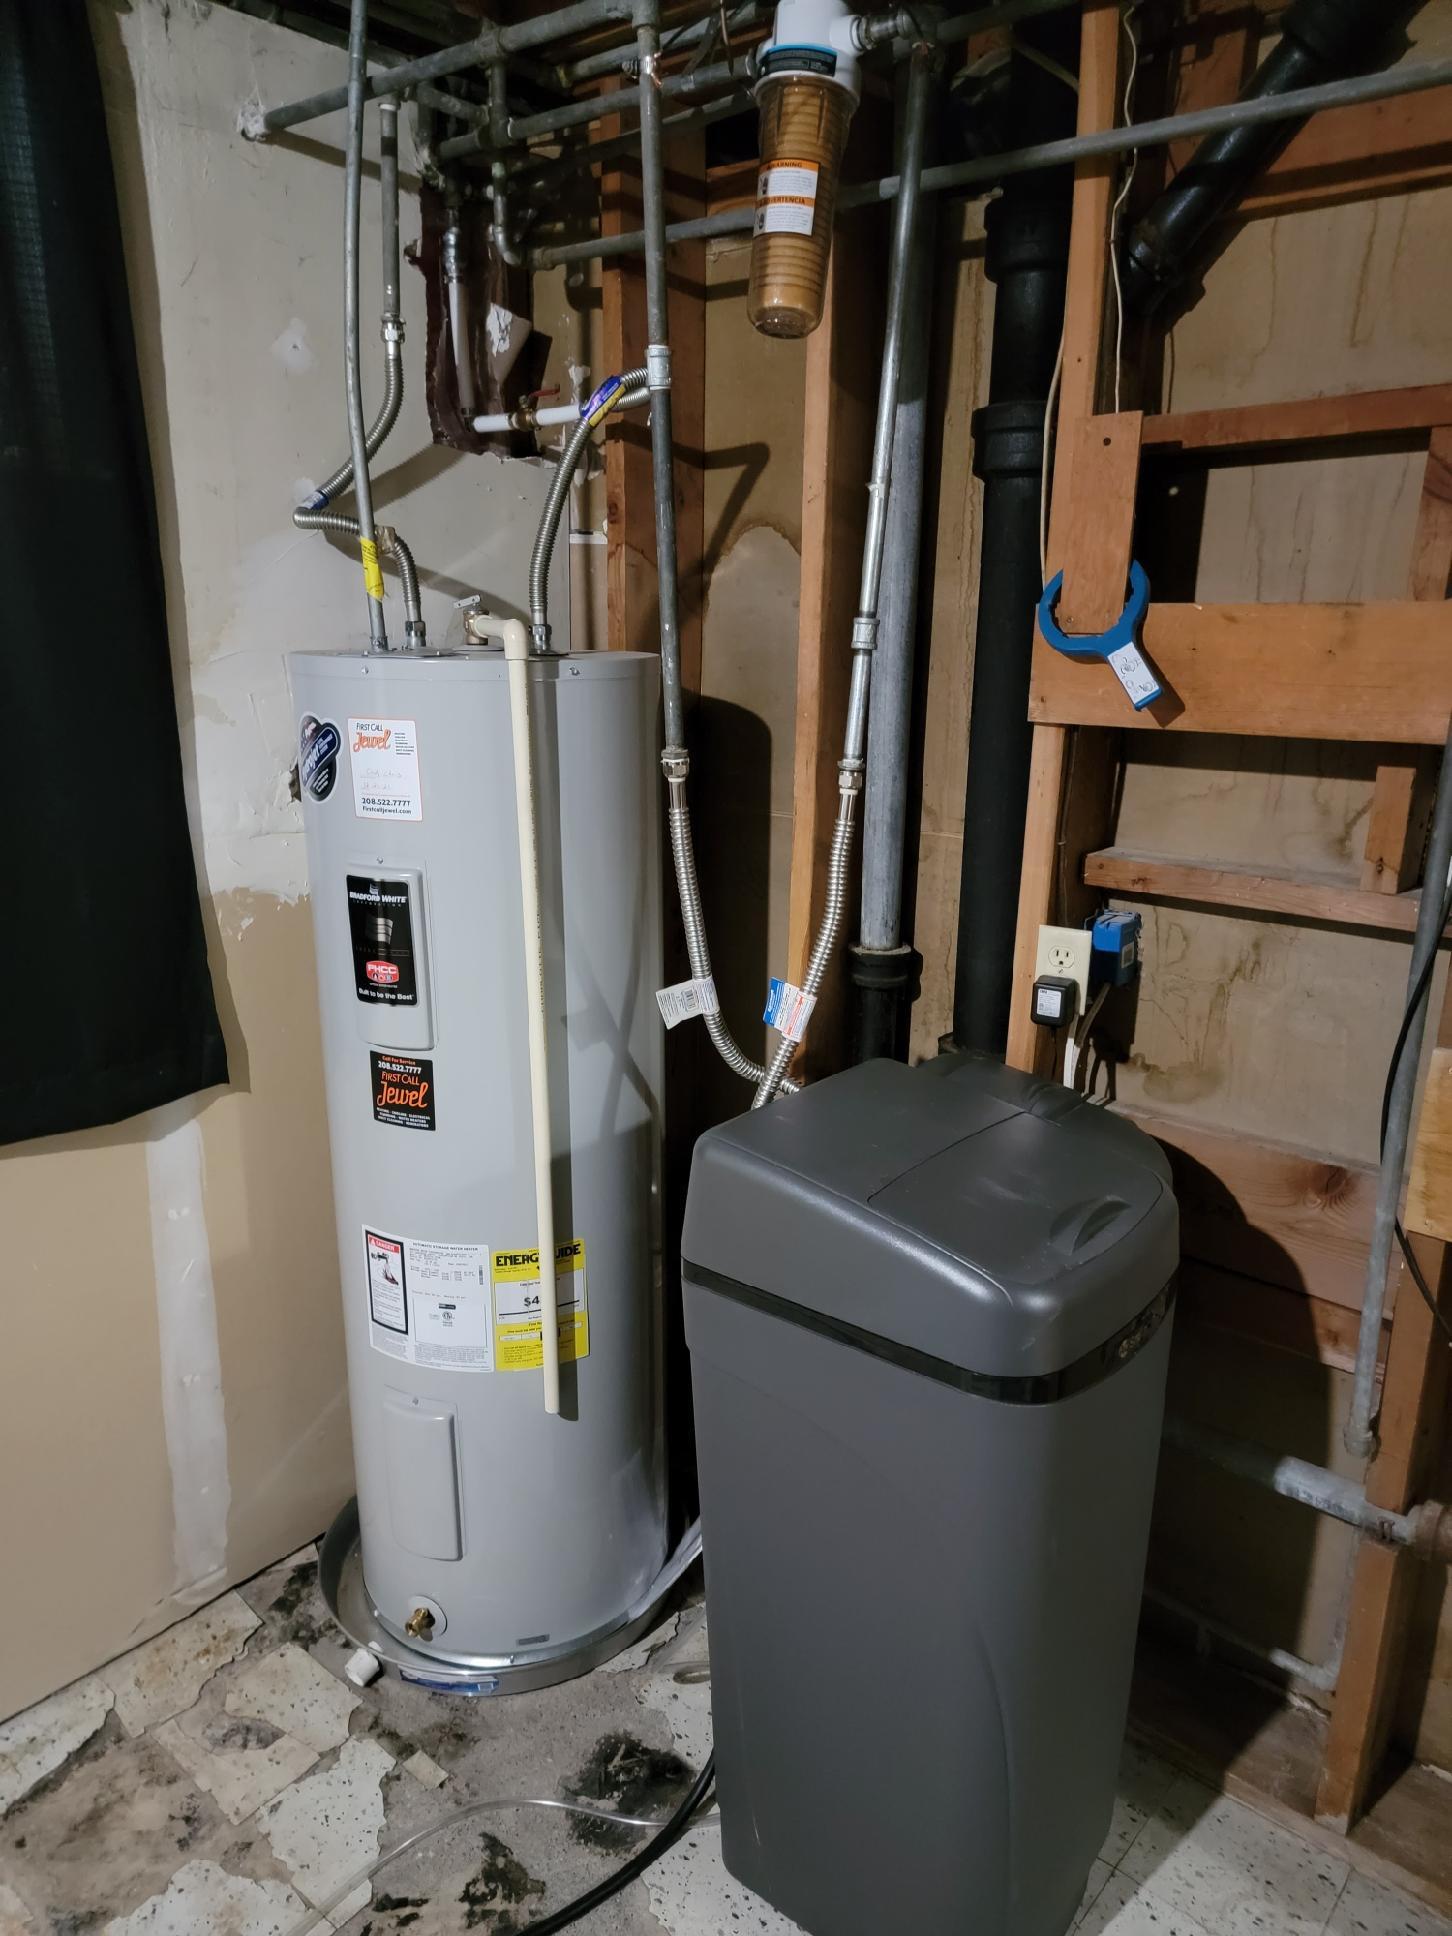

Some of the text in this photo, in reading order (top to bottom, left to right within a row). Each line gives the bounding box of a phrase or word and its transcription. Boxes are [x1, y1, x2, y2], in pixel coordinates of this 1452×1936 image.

[356, 723, 383, 732] FIRST CALL
[353, 728, 391, 752] Jewel
[361, 797, 411, 806] 208.522.7777
[349, 891, 380, 902] BRADFORD
[381, 895, 407, 903] WHITE
[367, 964, 397, 974] PHCC
[378, 1061, 421, 1074] 208.522.7777
[381, 1071, 420, 1085] FIRST CALL
[376, 1081, 429, 1108] Jewel
